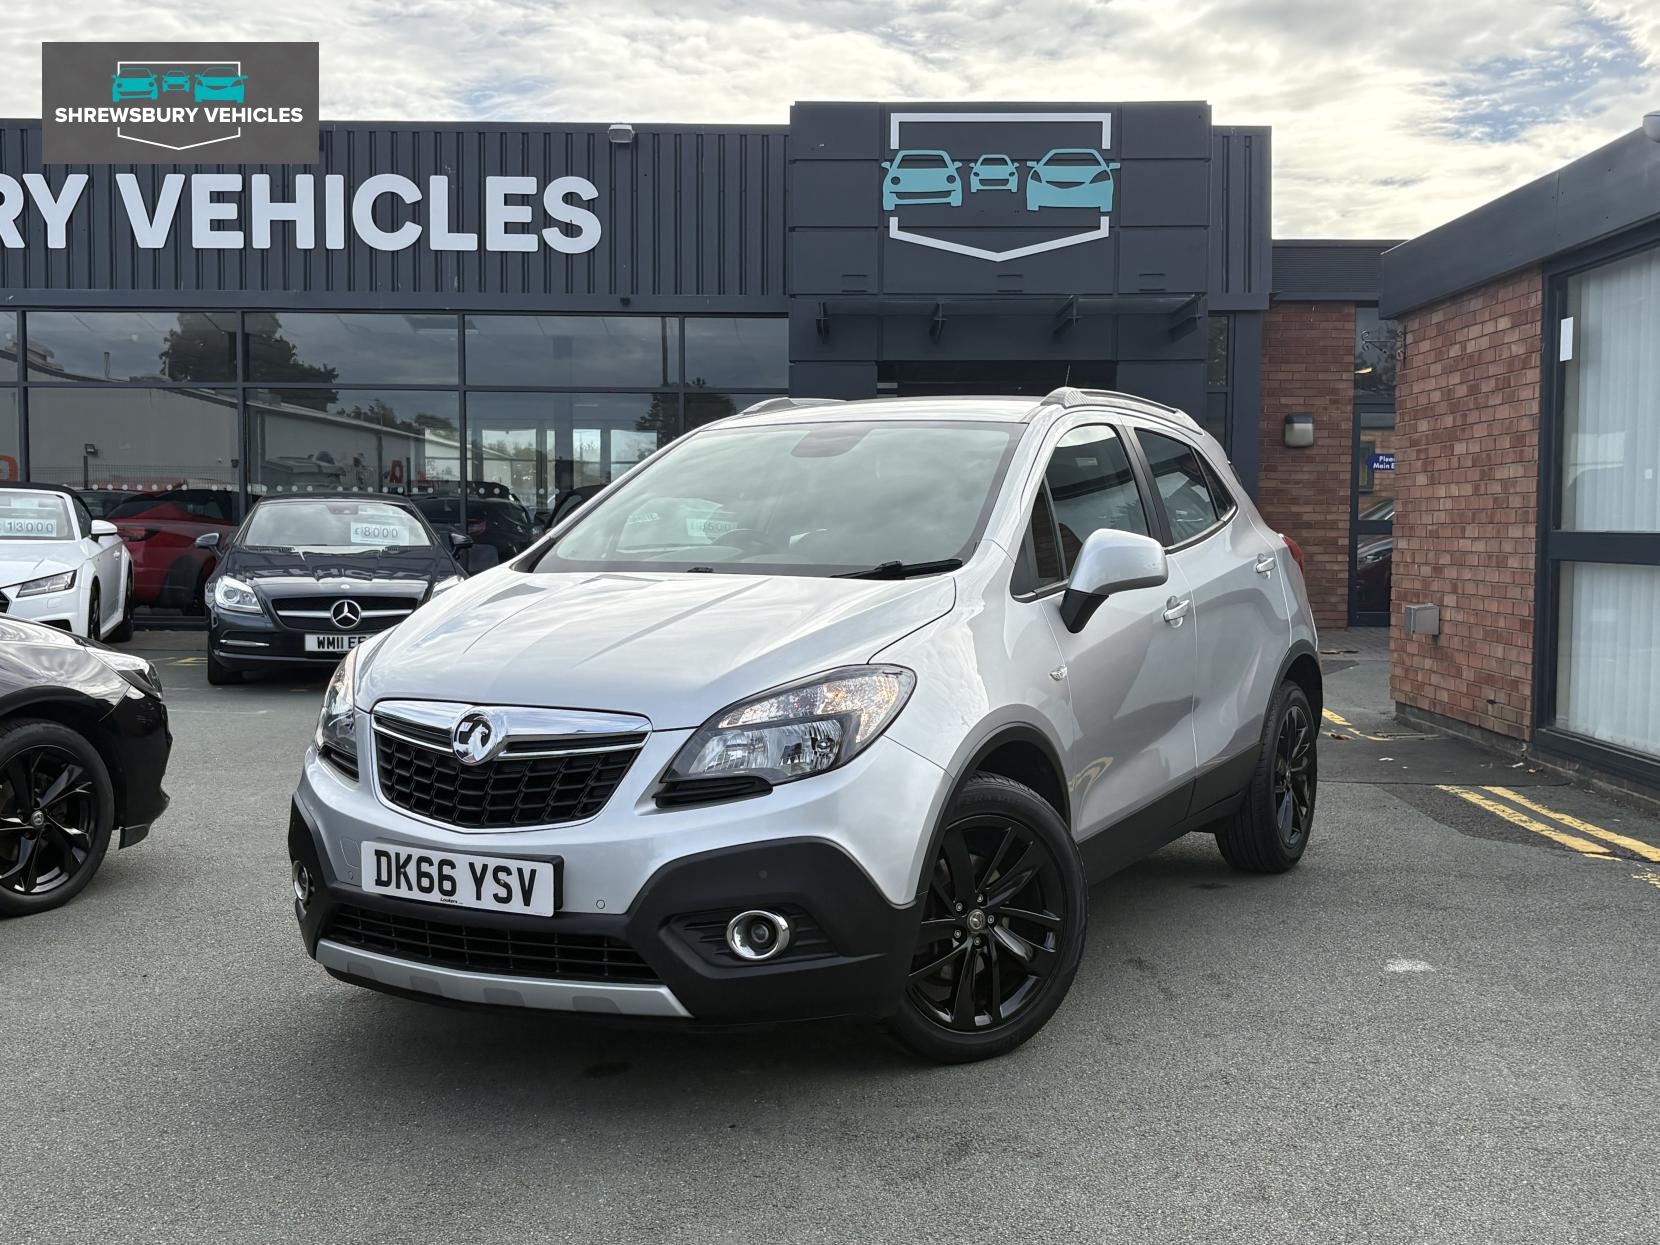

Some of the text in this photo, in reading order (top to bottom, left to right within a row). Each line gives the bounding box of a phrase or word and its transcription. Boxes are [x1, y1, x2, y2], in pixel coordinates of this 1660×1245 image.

[115, 173, 602, 254] VEHICLES
[7, 521, 54, 533] 13000
[316, 636, 344, 649] WM11
[374, 849, 537, 907] DK66 YSV
